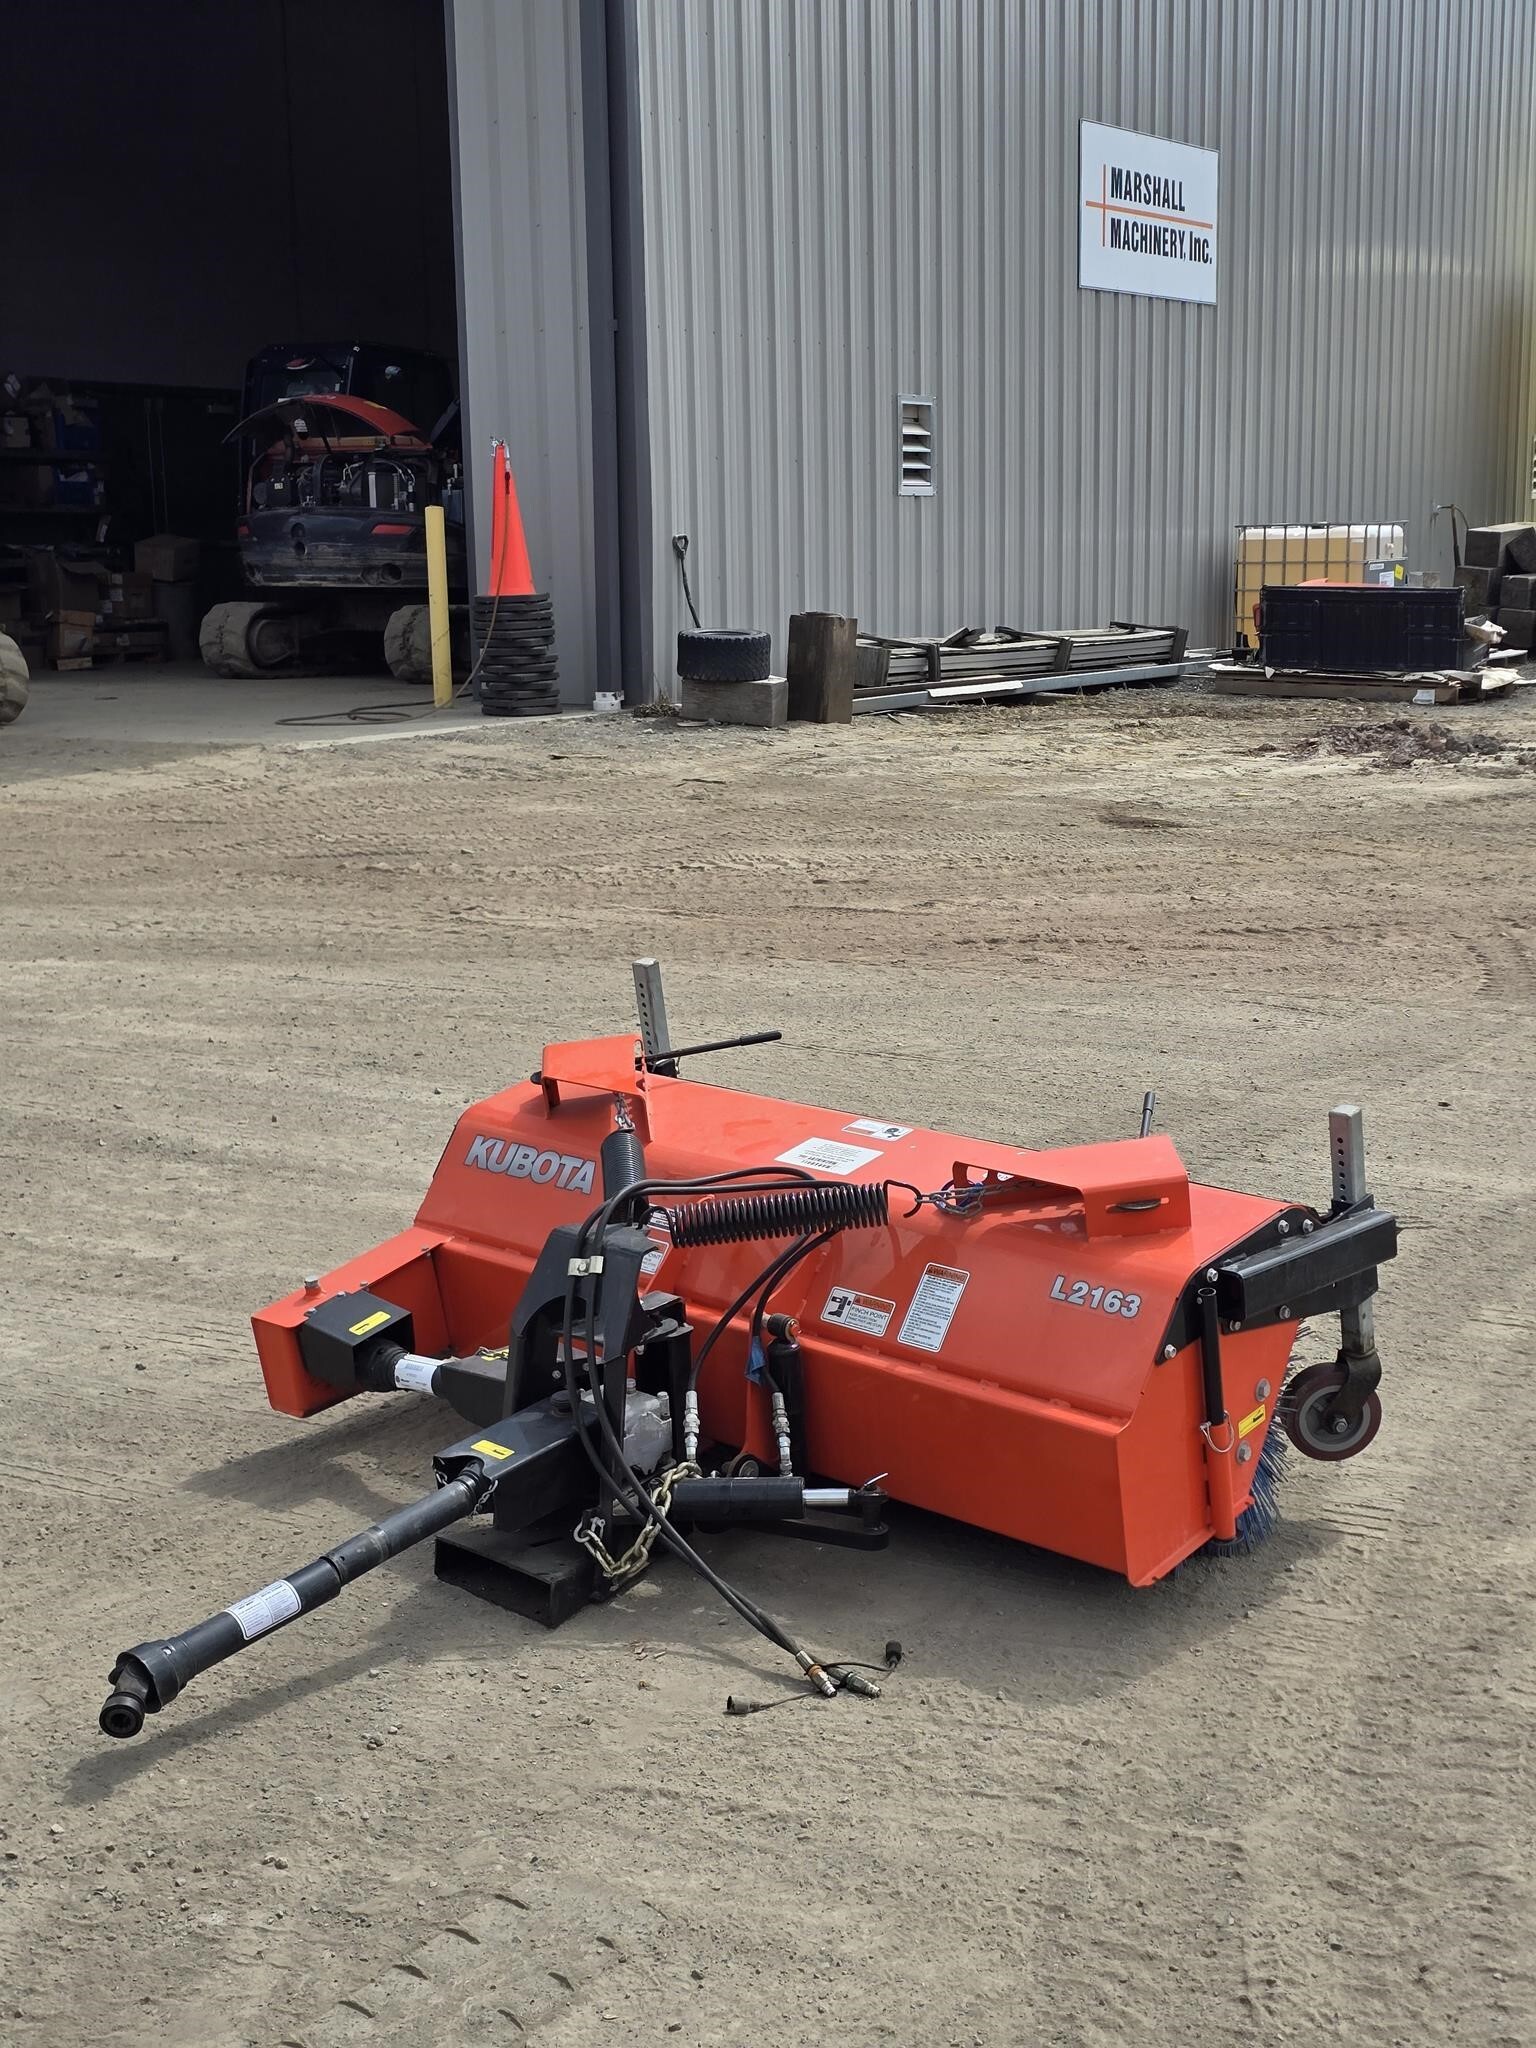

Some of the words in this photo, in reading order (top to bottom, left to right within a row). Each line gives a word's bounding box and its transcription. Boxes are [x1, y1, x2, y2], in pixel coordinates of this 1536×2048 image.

[1110, 166, 1185, 212] MARSHALL
[1189, 231, 1213, 264] Inc.
[464, 1135, 597, 1195] KUBOTA
[1050, 1275, 1142, 1318] L2163
